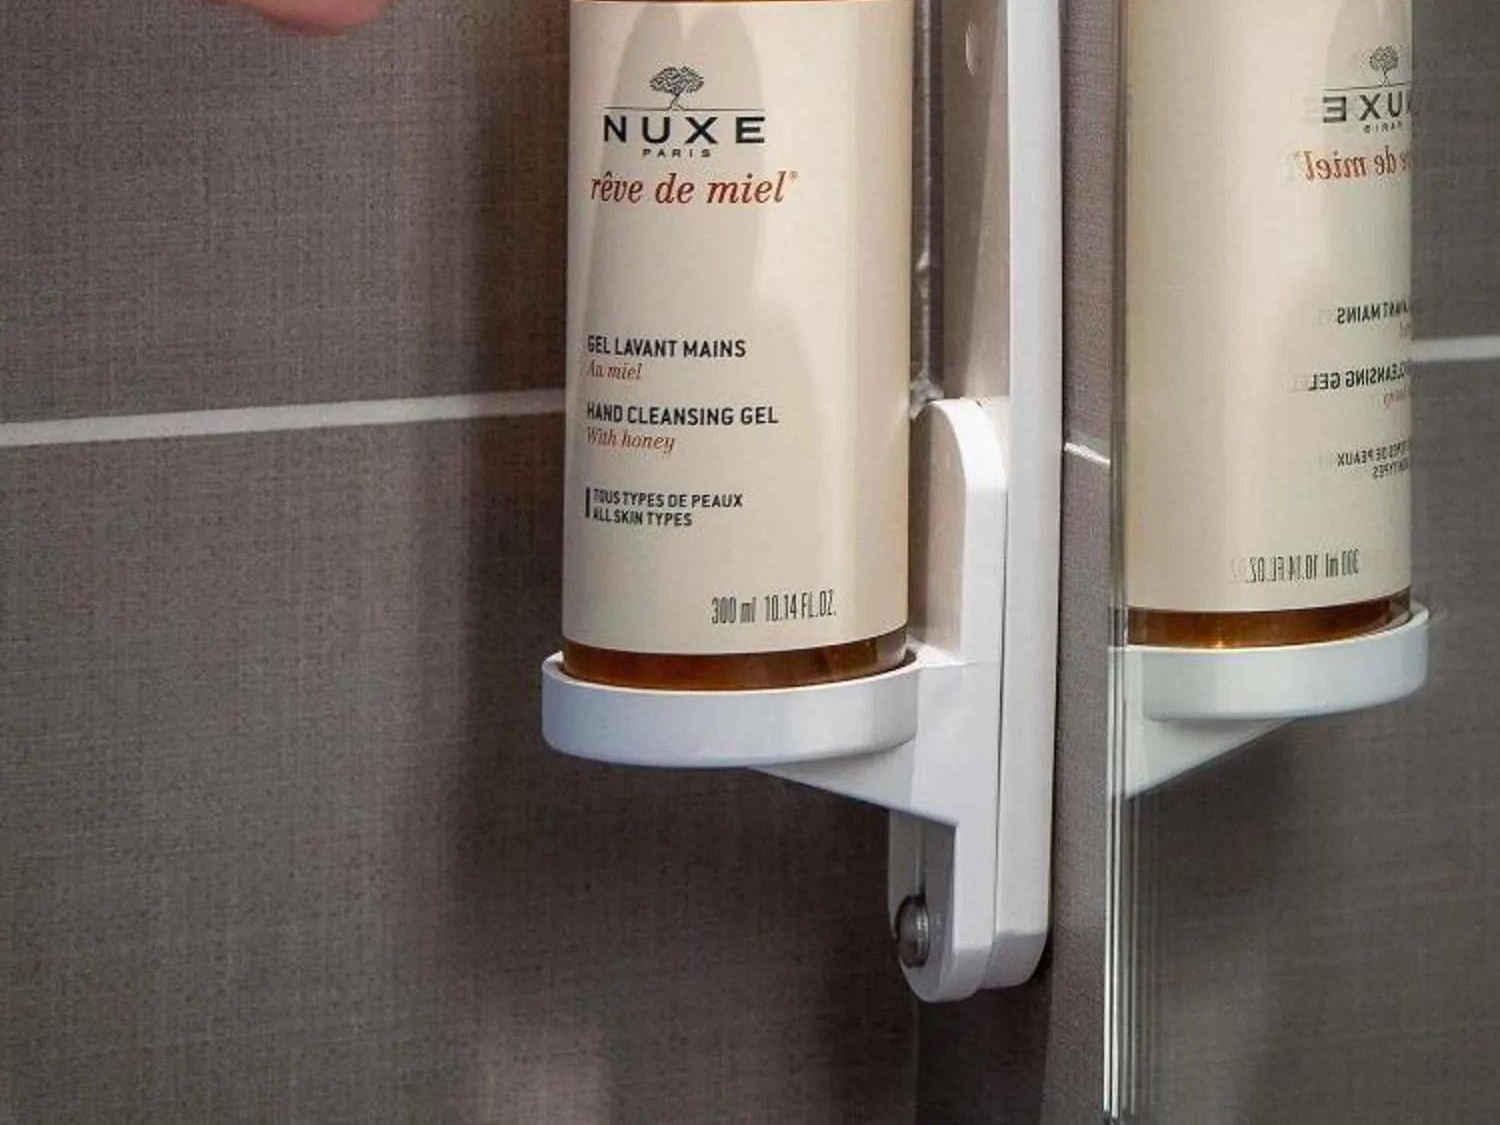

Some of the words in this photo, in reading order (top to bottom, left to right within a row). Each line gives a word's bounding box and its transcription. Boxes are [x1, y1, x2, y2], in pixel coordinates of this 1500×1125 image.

[604, 115, 765, 143] NUXE
[643, 148, 711, 158] PARIS
[591, 171, 643, 203] rêve
[655, 173, 694, 203] de
[587, 335, 610, 355] GEL
[615, 337, 676, 358] LAVANT
[683, 340, 747, 358] MAINS
[608, 362, 642, 380] miel
[587, 402, 623, 423] HAND
[627, 405, 733, 426] CLEANSING
[741, 407, 778, 425] GEL
[620, 430, 675, 453] honey
[593, 488, 620, 506] TOUS
[623, 490, 666, 508] TYPES
[668, 493, 687, 508] DE
[692, 493, 743, 508] PEAUX
[593, 506, 613, 523] ALL
[614, 509, 643, 525] SKIN
[647, 512, 692, 527] TYPES
[712, 597, 736, 624] 300
[765, 592, 797, 622] 10.14
